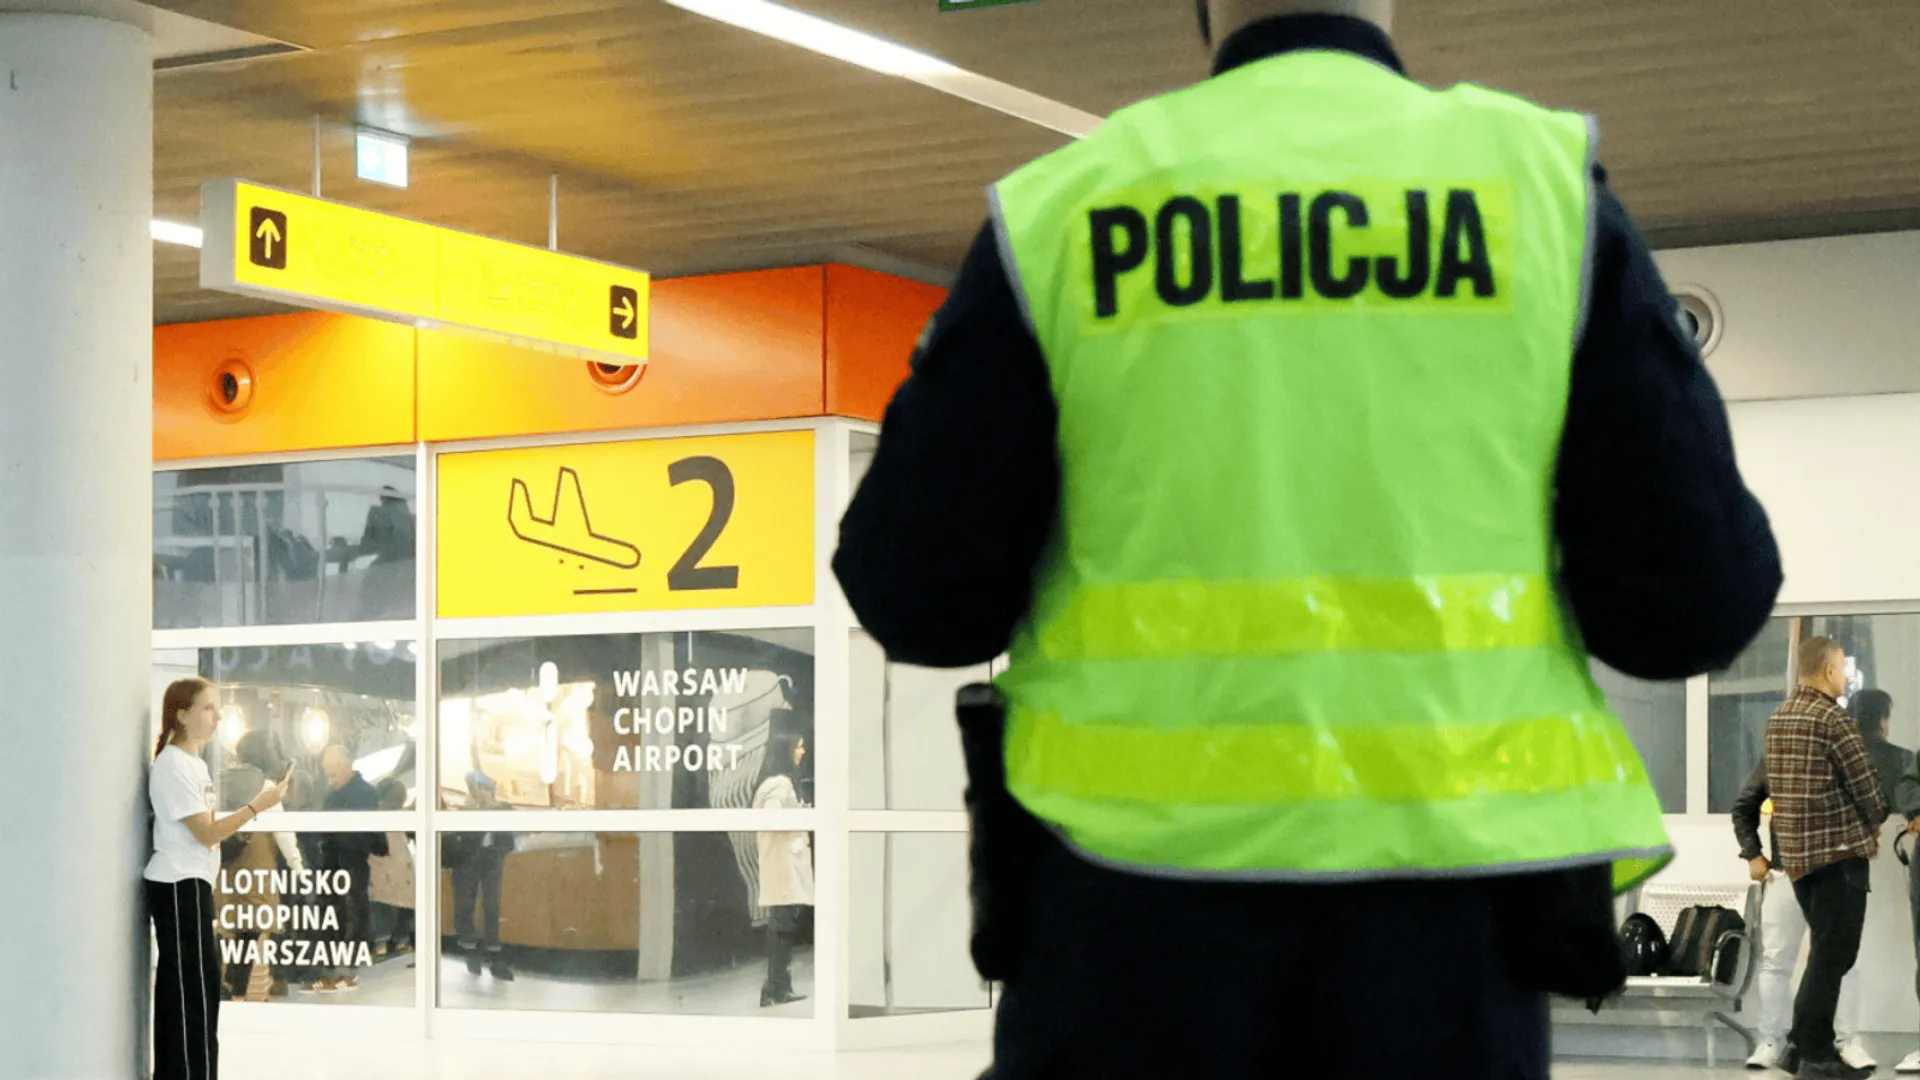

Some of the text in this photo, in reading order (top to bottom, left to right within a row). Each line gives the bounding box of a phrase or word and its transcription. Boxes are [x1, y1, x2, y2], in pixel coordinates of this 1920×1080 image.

[1088, 188, 1496, 318] POLICJA
[667, 456, 739, 591] 2
[613, 668, 747, 696] WARSAW
[613, 707, 728, 735] CHOPIN
[613, 745, 743, 772] AIRPORT
[220, 869, 352, 895] LOTNISKO
[220, 904, 339, 931] CHOPINA
[219, 939, 373, 967] WARSZAWA
